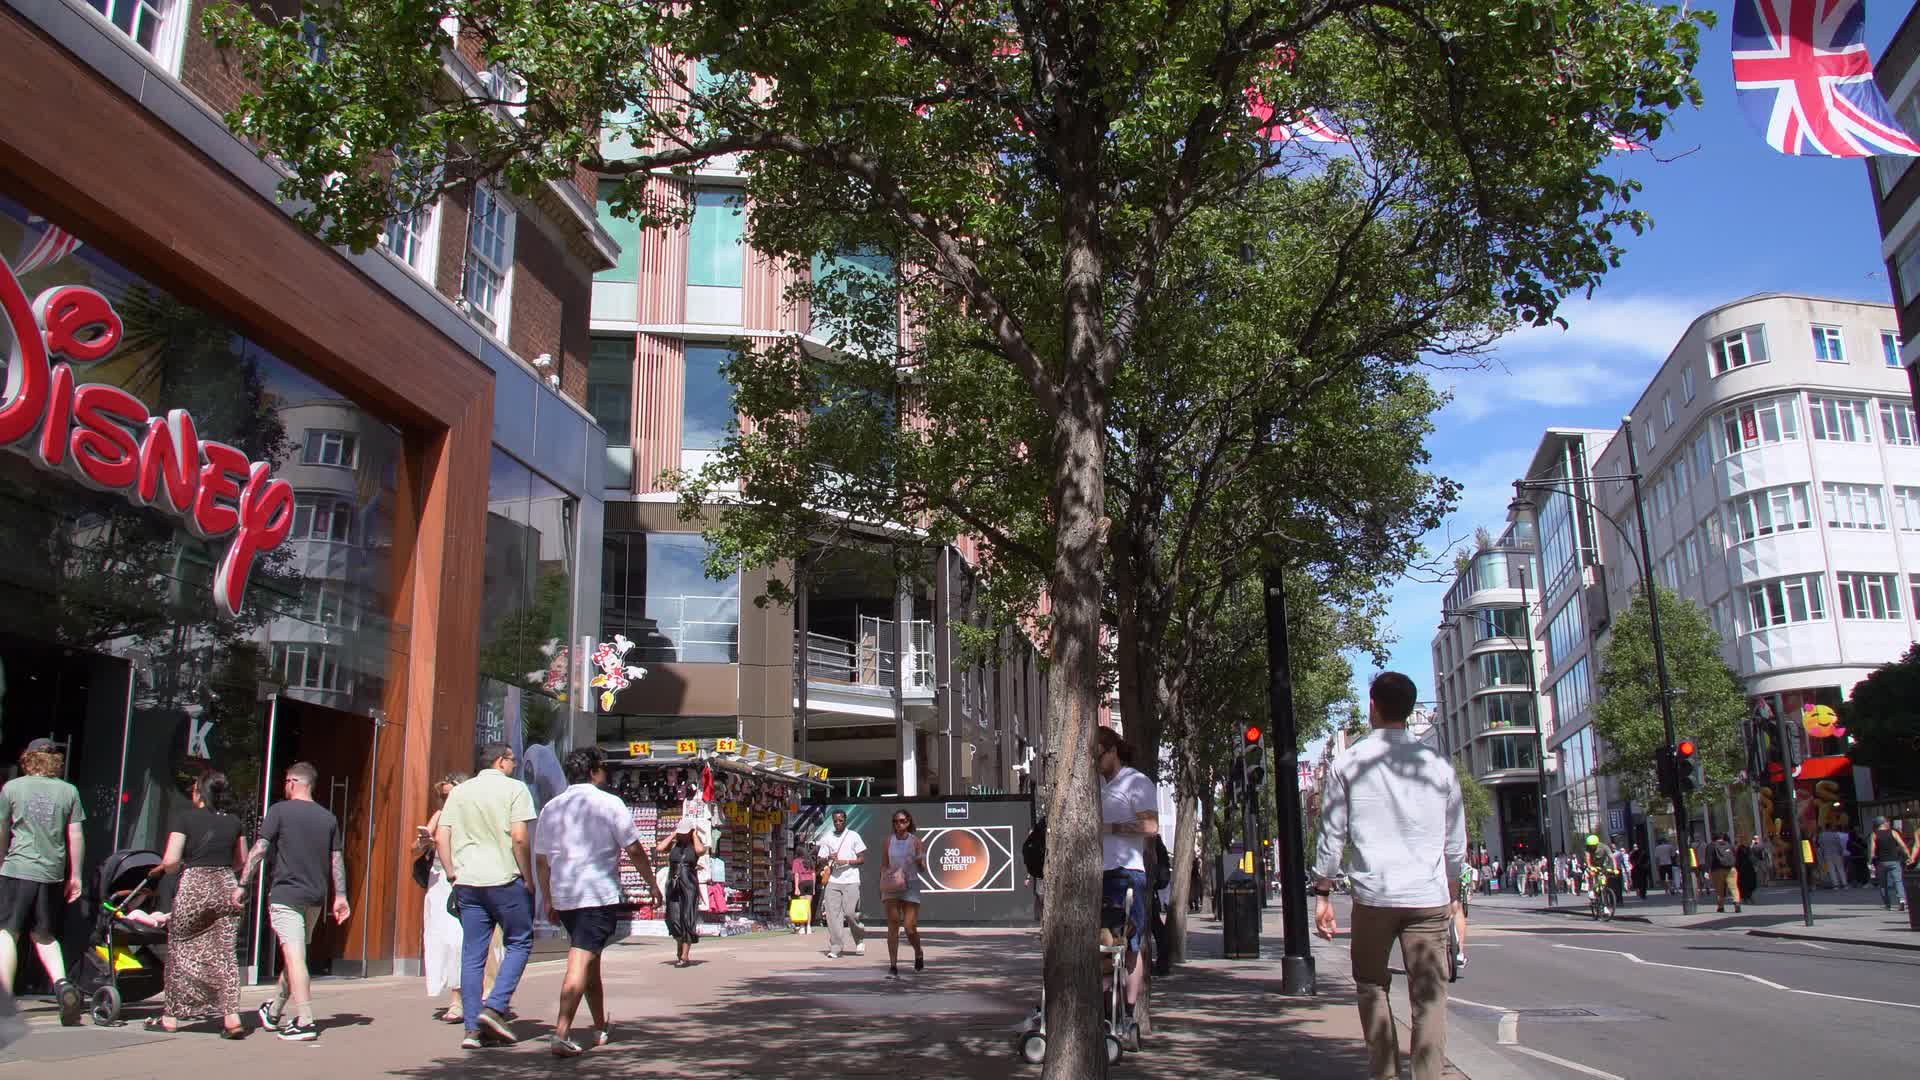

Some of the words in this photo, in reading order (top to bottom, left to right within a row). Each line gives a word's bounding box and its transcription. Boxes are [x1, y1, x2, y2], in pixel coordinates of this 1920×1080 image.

[632, 743, 647, 753] £1
[680, 742, 695, 752] £1
[719, 740, 733, 750] £1
[944, 848, 960, 856] 340
[940, 855, 976, 864] OXFORD
[942, 863, 968, 871] STREET
